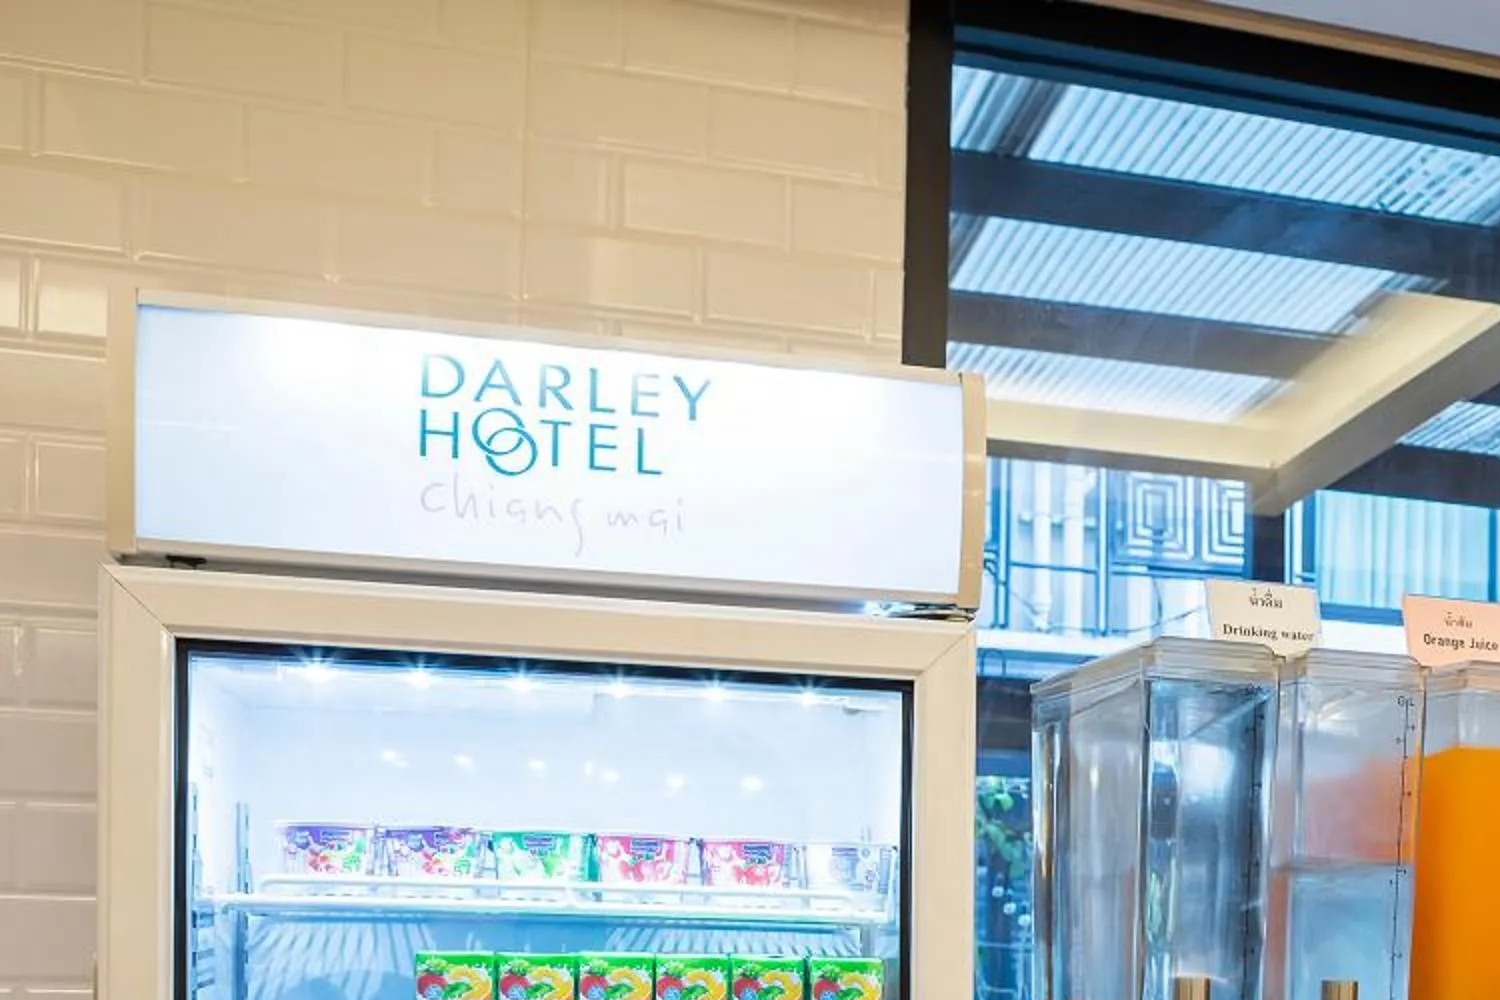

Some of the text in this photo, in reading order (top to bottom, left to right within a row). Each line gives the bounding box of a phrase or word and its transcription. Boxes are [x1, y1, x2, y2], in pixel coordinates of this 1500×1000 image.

[420, 353, 711, 421] DARLEY
[419, 407, 662, 476] HOTEL
[607, 497, 684, 537] mai
[1223, 623, 1315, 640] Drinking water
[1424, 634, 1499, 650] Orange Juice
